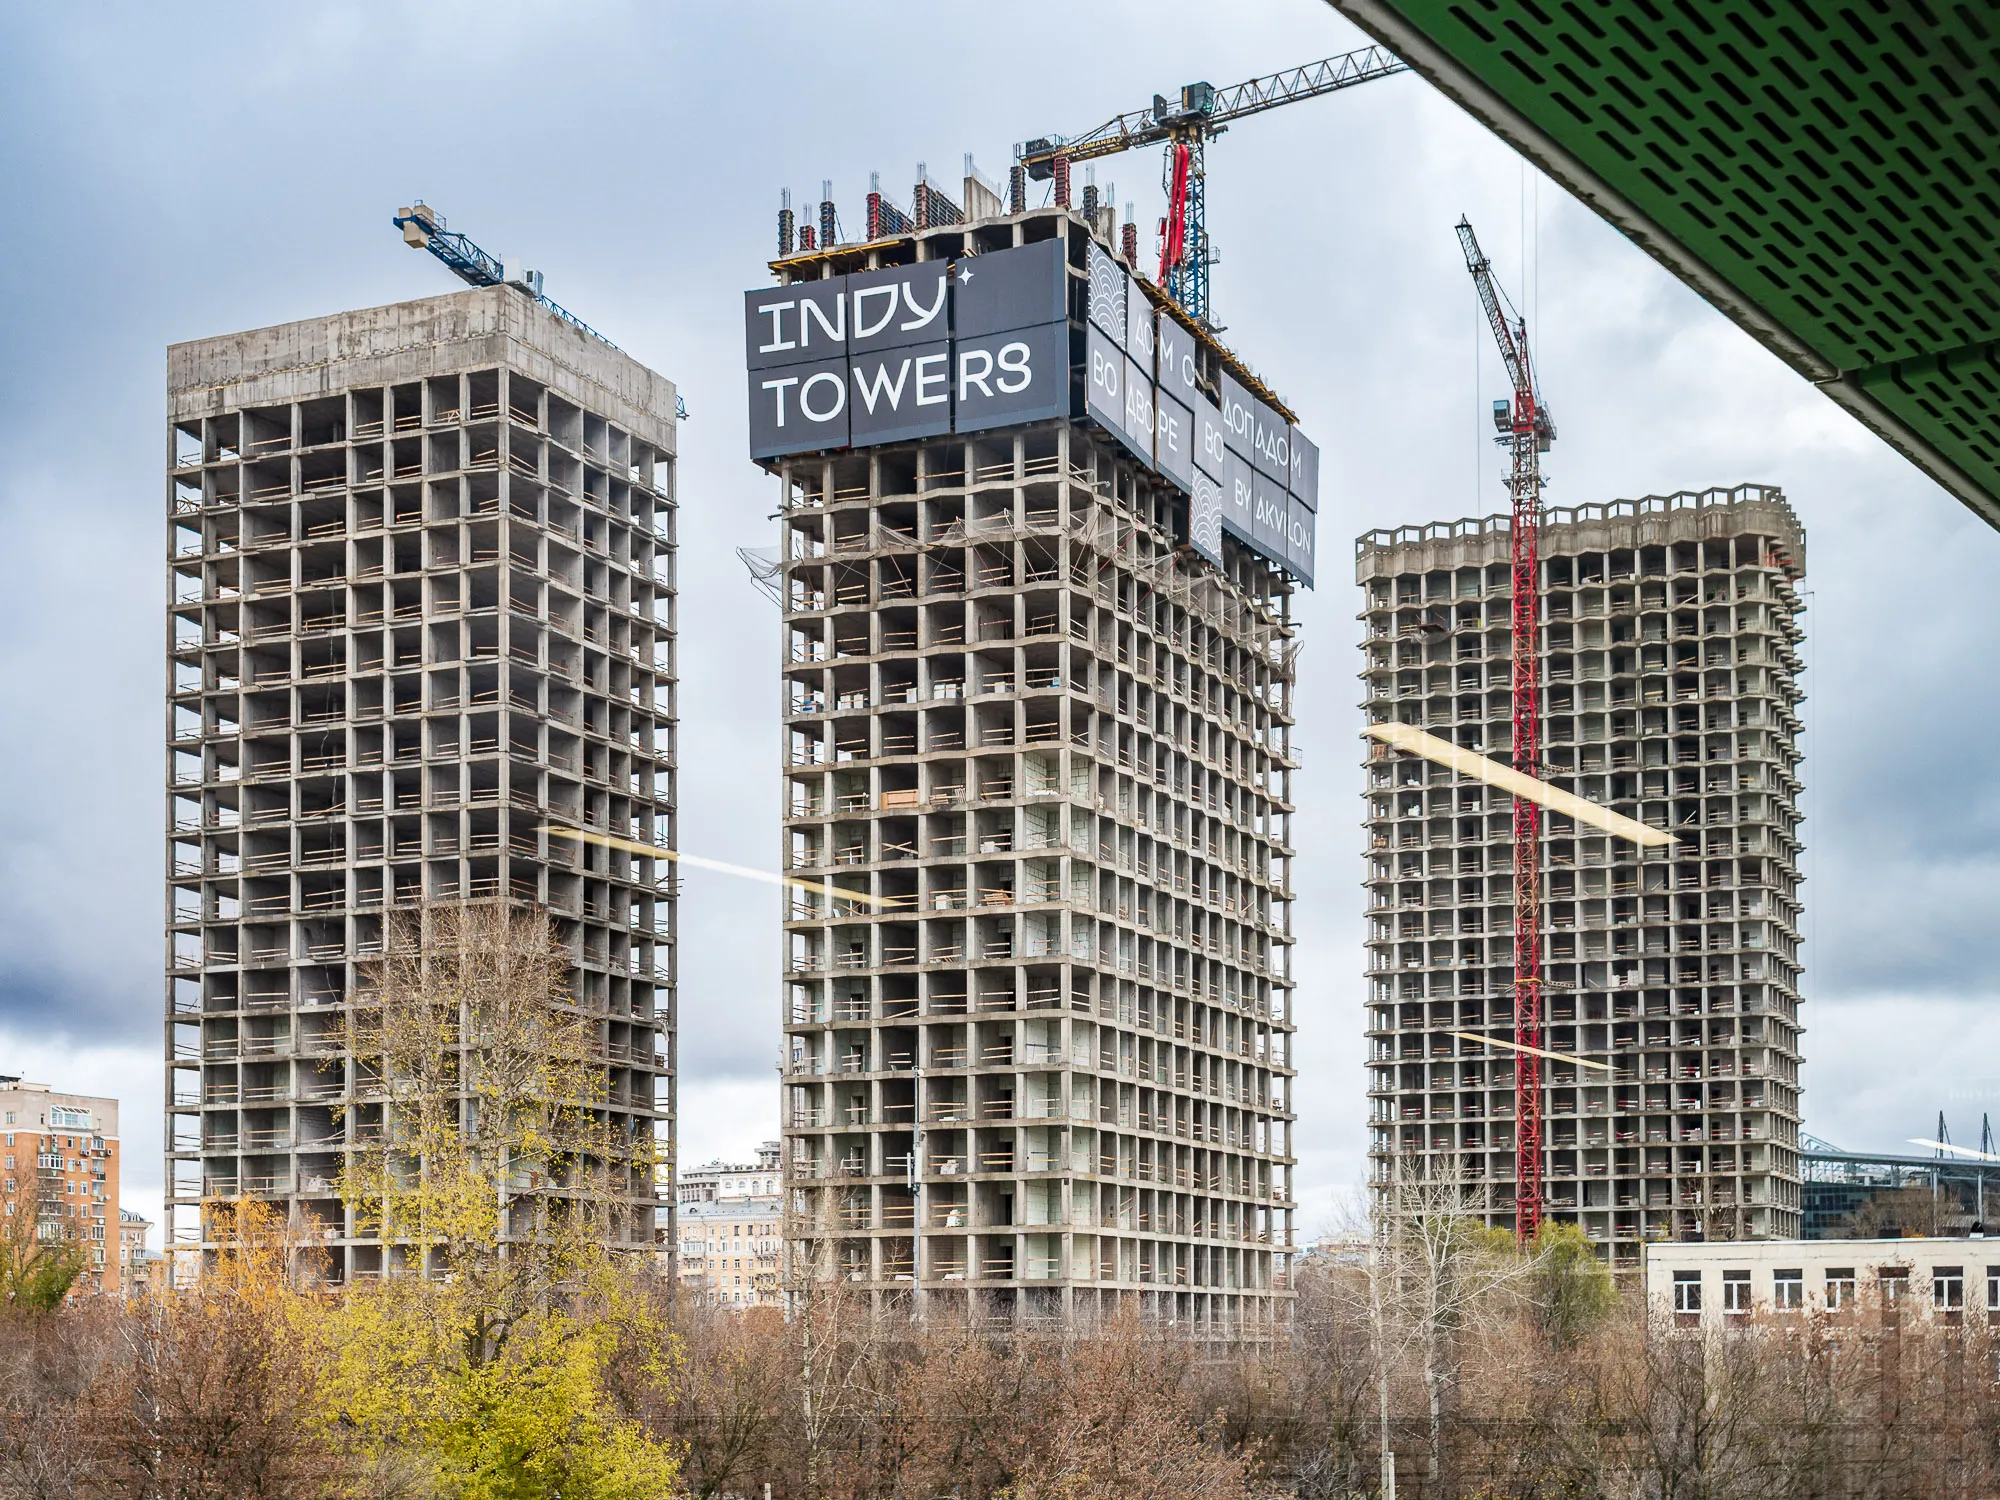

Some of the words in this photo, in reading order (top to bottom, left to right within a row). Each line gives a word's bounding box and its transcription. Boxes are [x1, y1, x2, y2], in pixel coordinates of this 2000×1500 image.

[1078, 138, 1117, 152] COMANSA
[758, 276, 947, 354] INDY
[1135, 314, 1174, 372] ДОМ
[761, 342, 1032, 428] TOWERS
[1093, 350, 1117, 398] ВО
[1126, 381, 1178, 452] ДВОРЕ
[1235, 478, 1252, 512] BY
[1256, 495, 1311, 555] AKVILON
